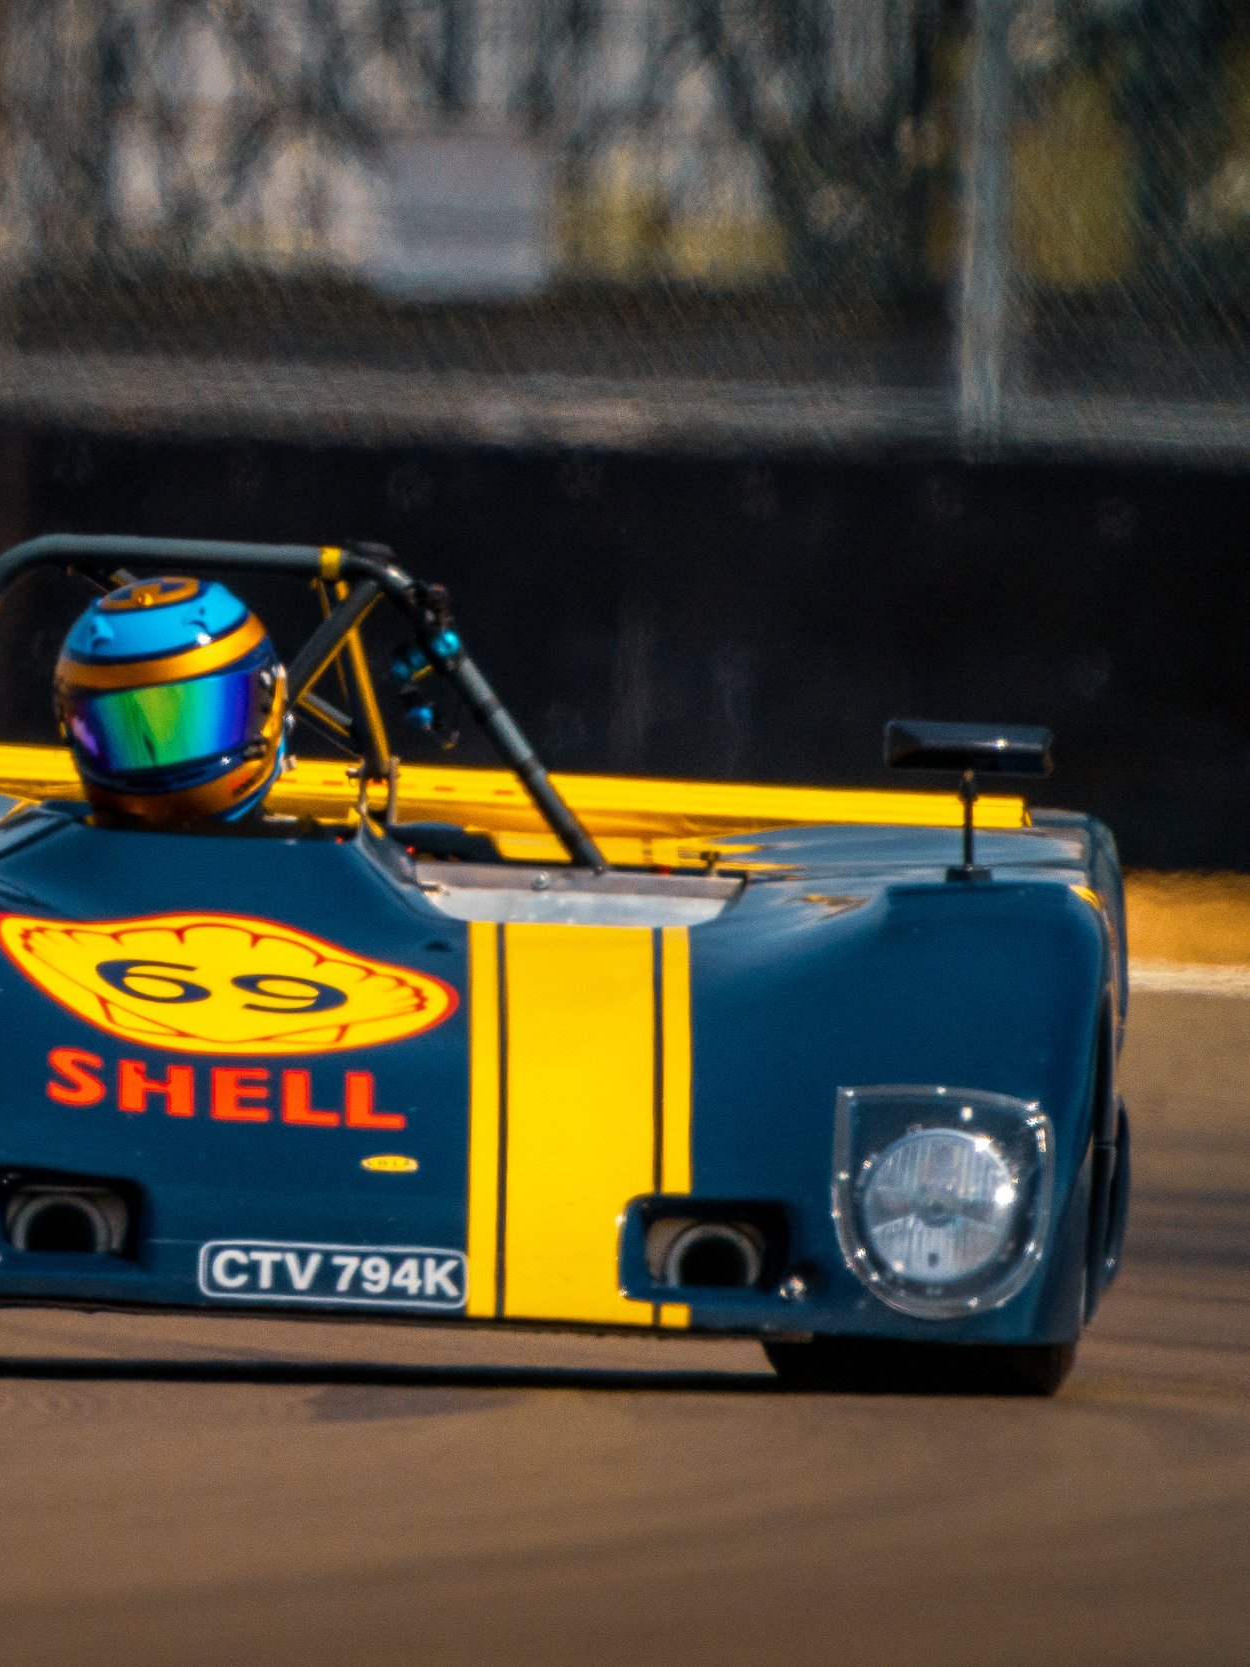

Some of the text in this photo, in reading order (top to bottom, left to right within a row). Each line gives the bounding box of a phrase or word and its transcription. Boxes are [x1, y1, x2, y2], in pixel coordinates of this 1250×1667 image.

[96, 959, 348, 1014] 69
[47, 1047, 406, 1129] SHELL
[212, 1249, 460, 1297] CTV 794K
